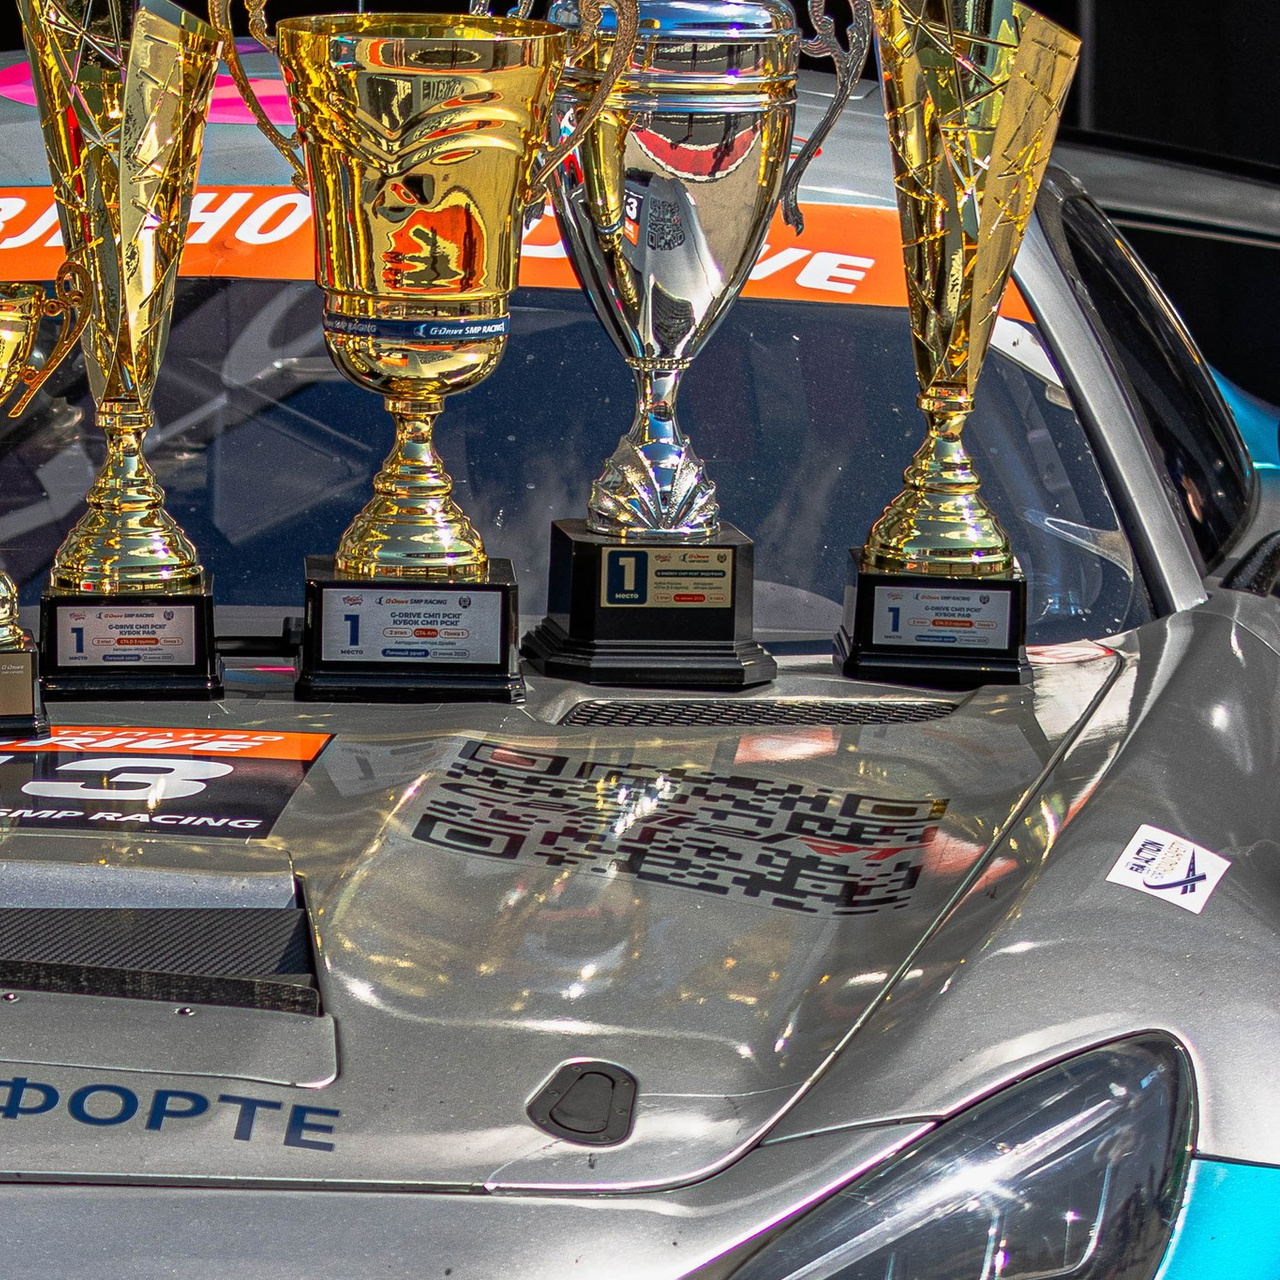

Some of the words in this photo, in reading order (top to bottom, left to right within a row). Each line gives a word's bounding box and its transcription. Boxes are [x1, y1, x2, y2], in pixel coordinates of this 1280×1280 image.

[465, 325, 482, 334] SMP
[619, 557, 635, 590] 1
[344, 615, 359, 646] 1
[888, 607, 899, 632] 1
[71, 627, 84, 653] 1
[88, 811, 263, 829] RACING
